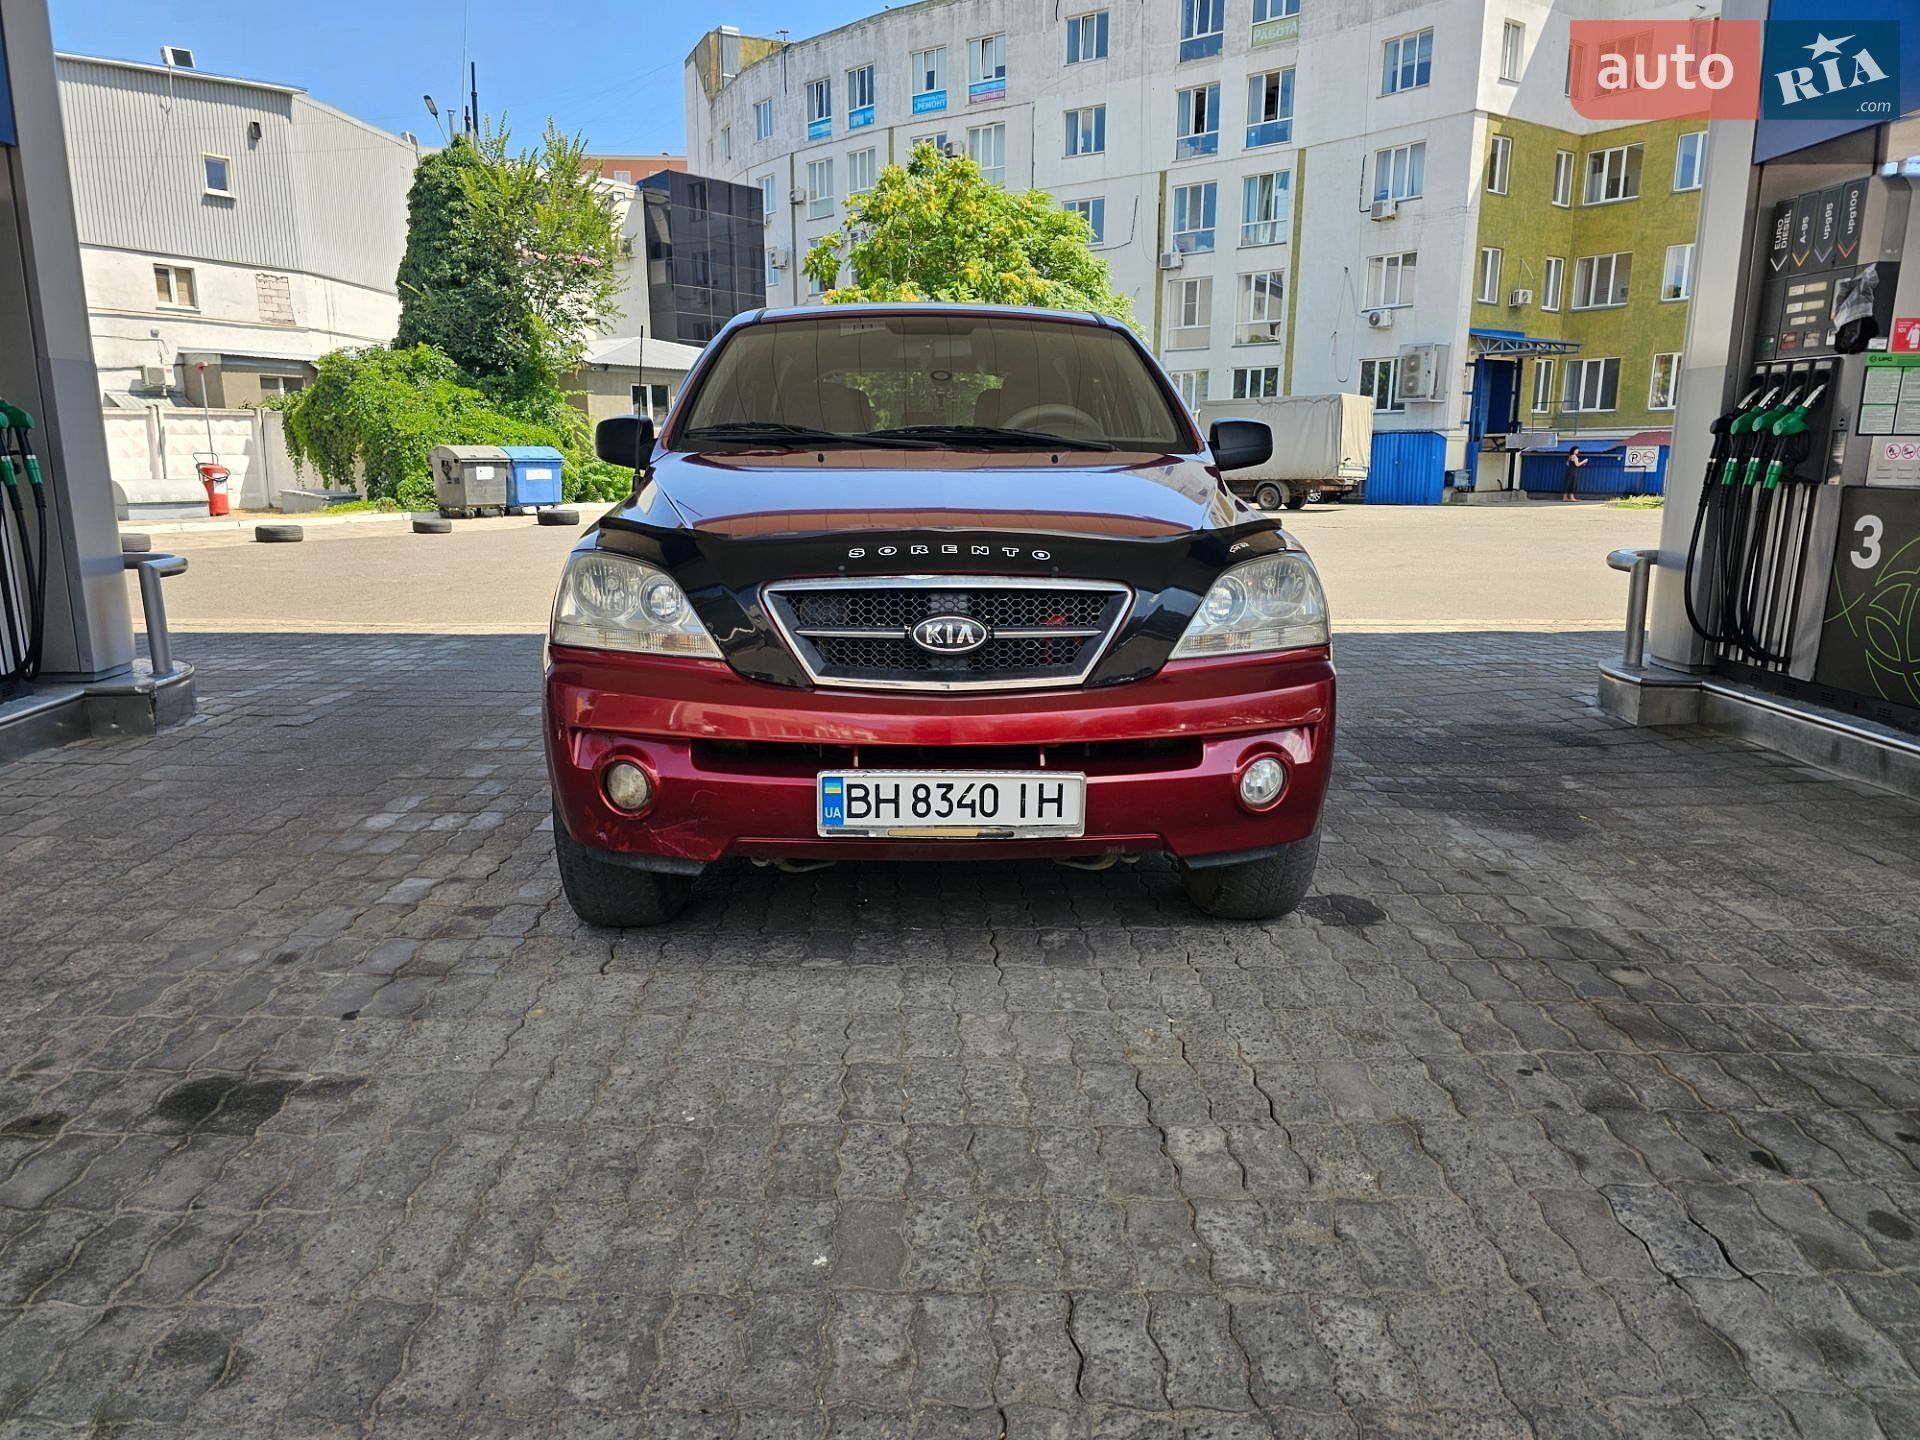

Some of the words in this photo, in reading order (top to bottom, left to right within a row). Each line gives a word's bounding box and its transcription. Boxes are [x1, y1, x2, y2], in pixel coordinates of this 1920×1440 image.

[1254, 20, 1298, 42] РАБОТА
[1847, 190, 1859, 234] upg100
[1775, 219, 1784, 250] EURO
[1781, 209, 1792, 248] DIESEL
[849, 545, 1050, 560] SORENTO
[1850, 514, 1884, 569] 3
[926, 623, 975, 644] KIA
[825, 807, 842, 819] UA
[846, 783, 900, 819] BH
[911, 783, 999, 818] 8340
[1019, 783, 1064, 818] IH
